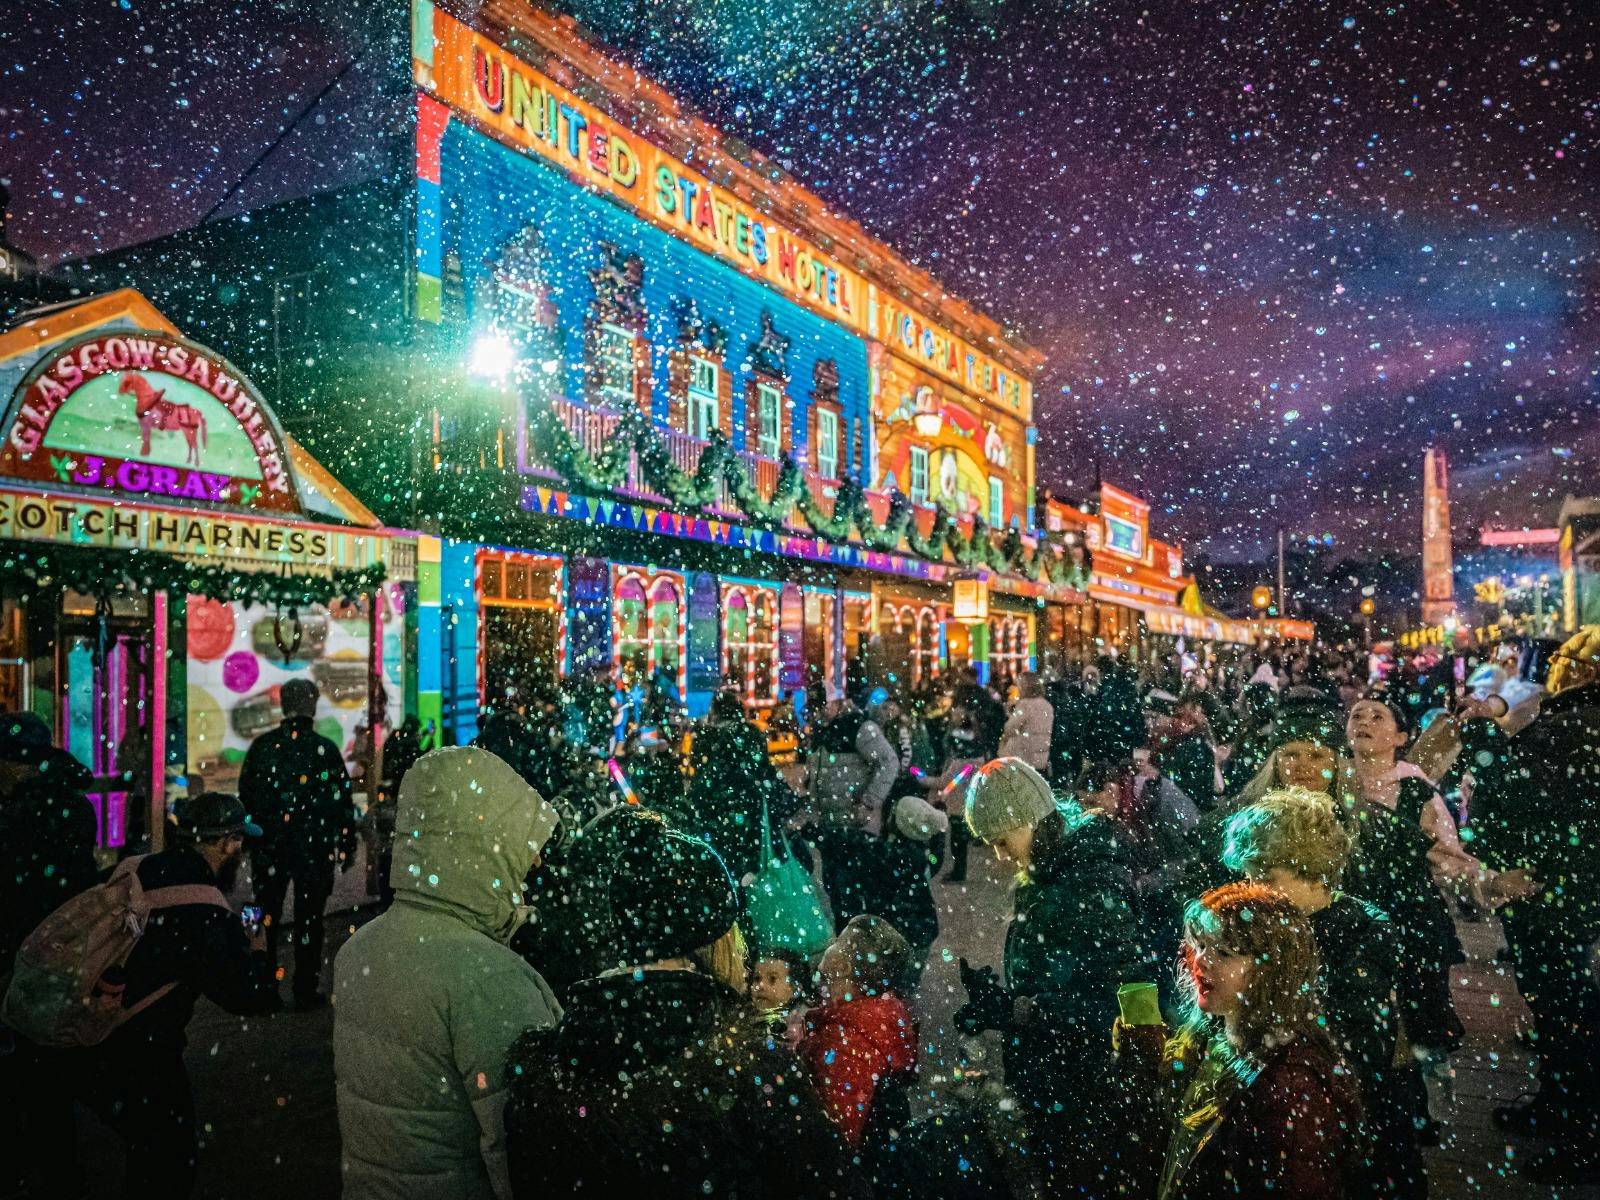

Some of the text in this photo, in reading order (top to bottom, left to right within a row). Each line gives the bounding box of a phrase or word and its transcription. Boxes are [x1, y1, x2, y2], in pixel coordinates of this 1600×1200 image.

[474, 50, 852, 313] UNITED STATES HOTEL
[10, 338, 289, 494] GLASGOW SADDLERY
[155, 516, 328, 557] HARNESS
